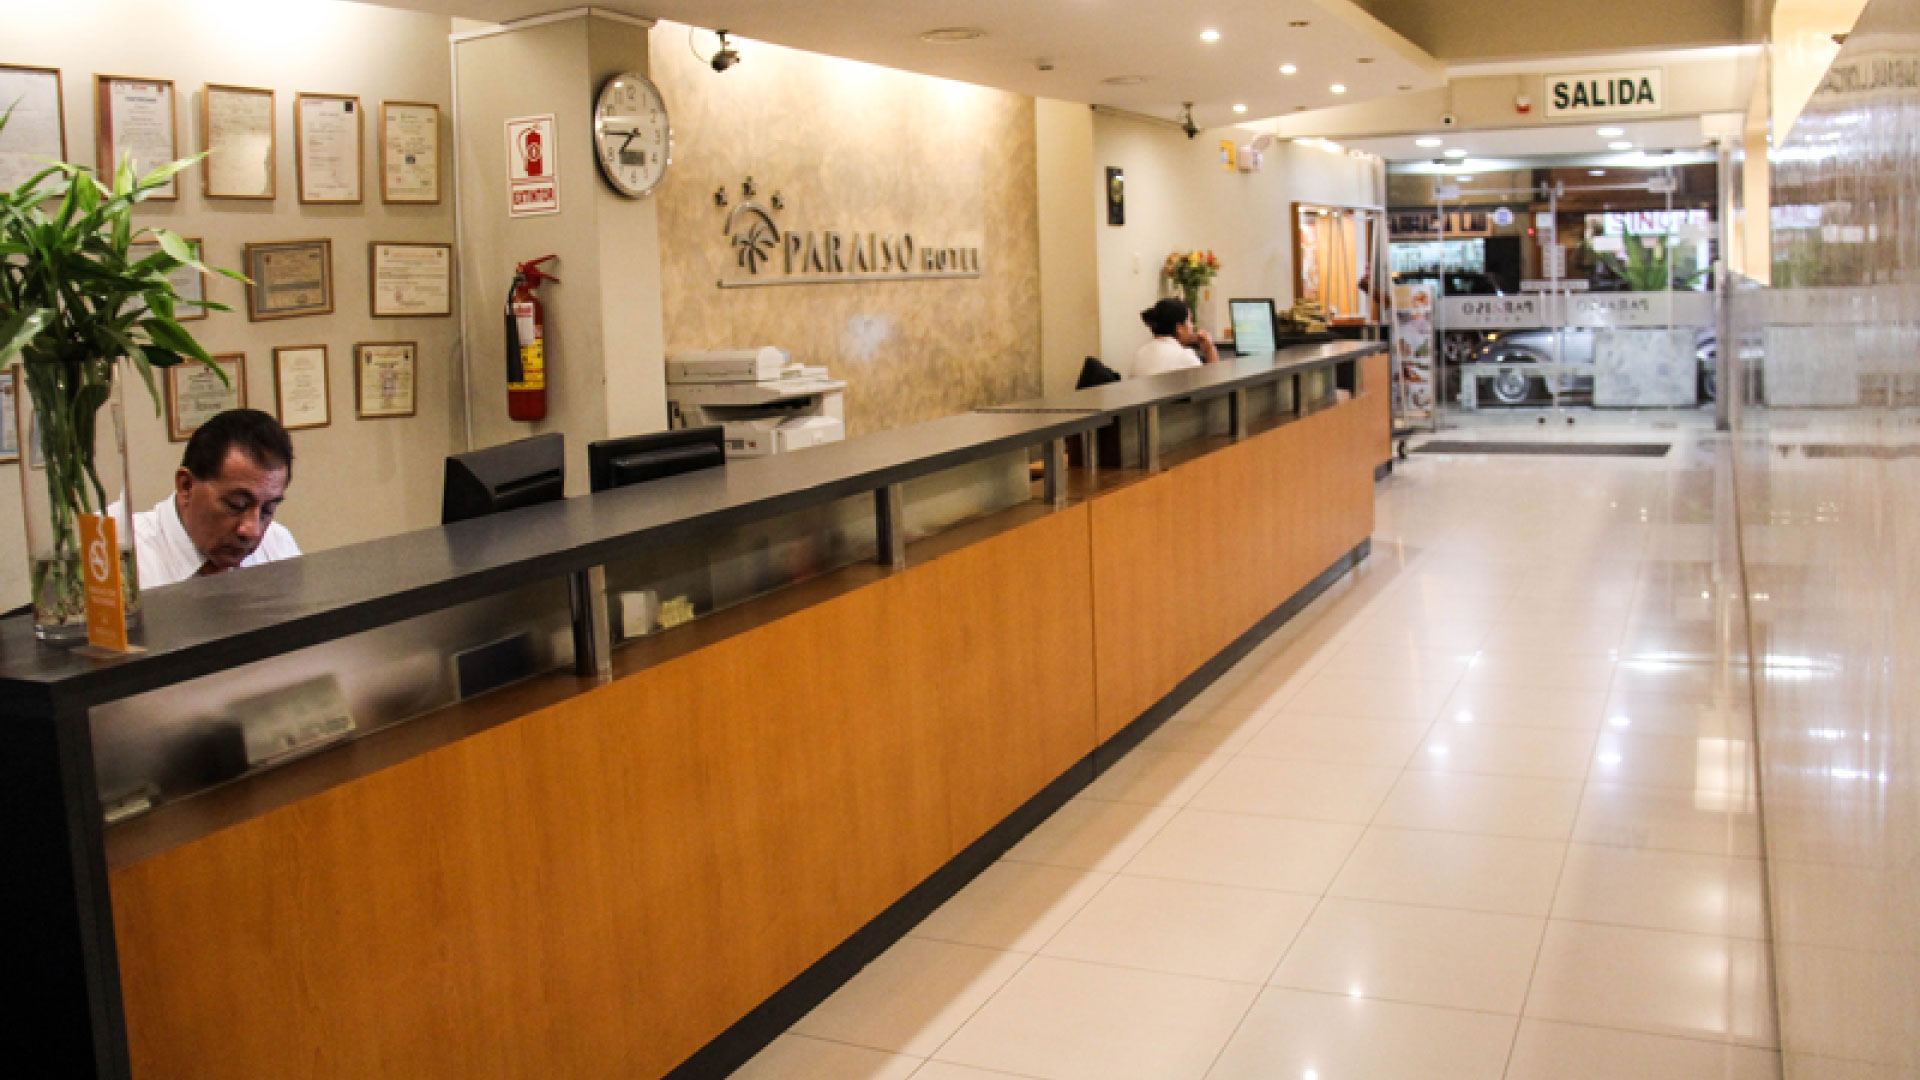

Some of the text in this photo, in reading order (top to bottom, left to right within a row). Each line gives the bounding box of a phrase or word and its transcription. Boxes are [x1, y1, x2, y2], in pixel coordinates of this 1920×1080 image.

[1553, 77, 1655, 110] SALIDA
[513, 188, 553, 205] EXTINTOR
[784, 231, 979, 274] PARAISO HOTEL
